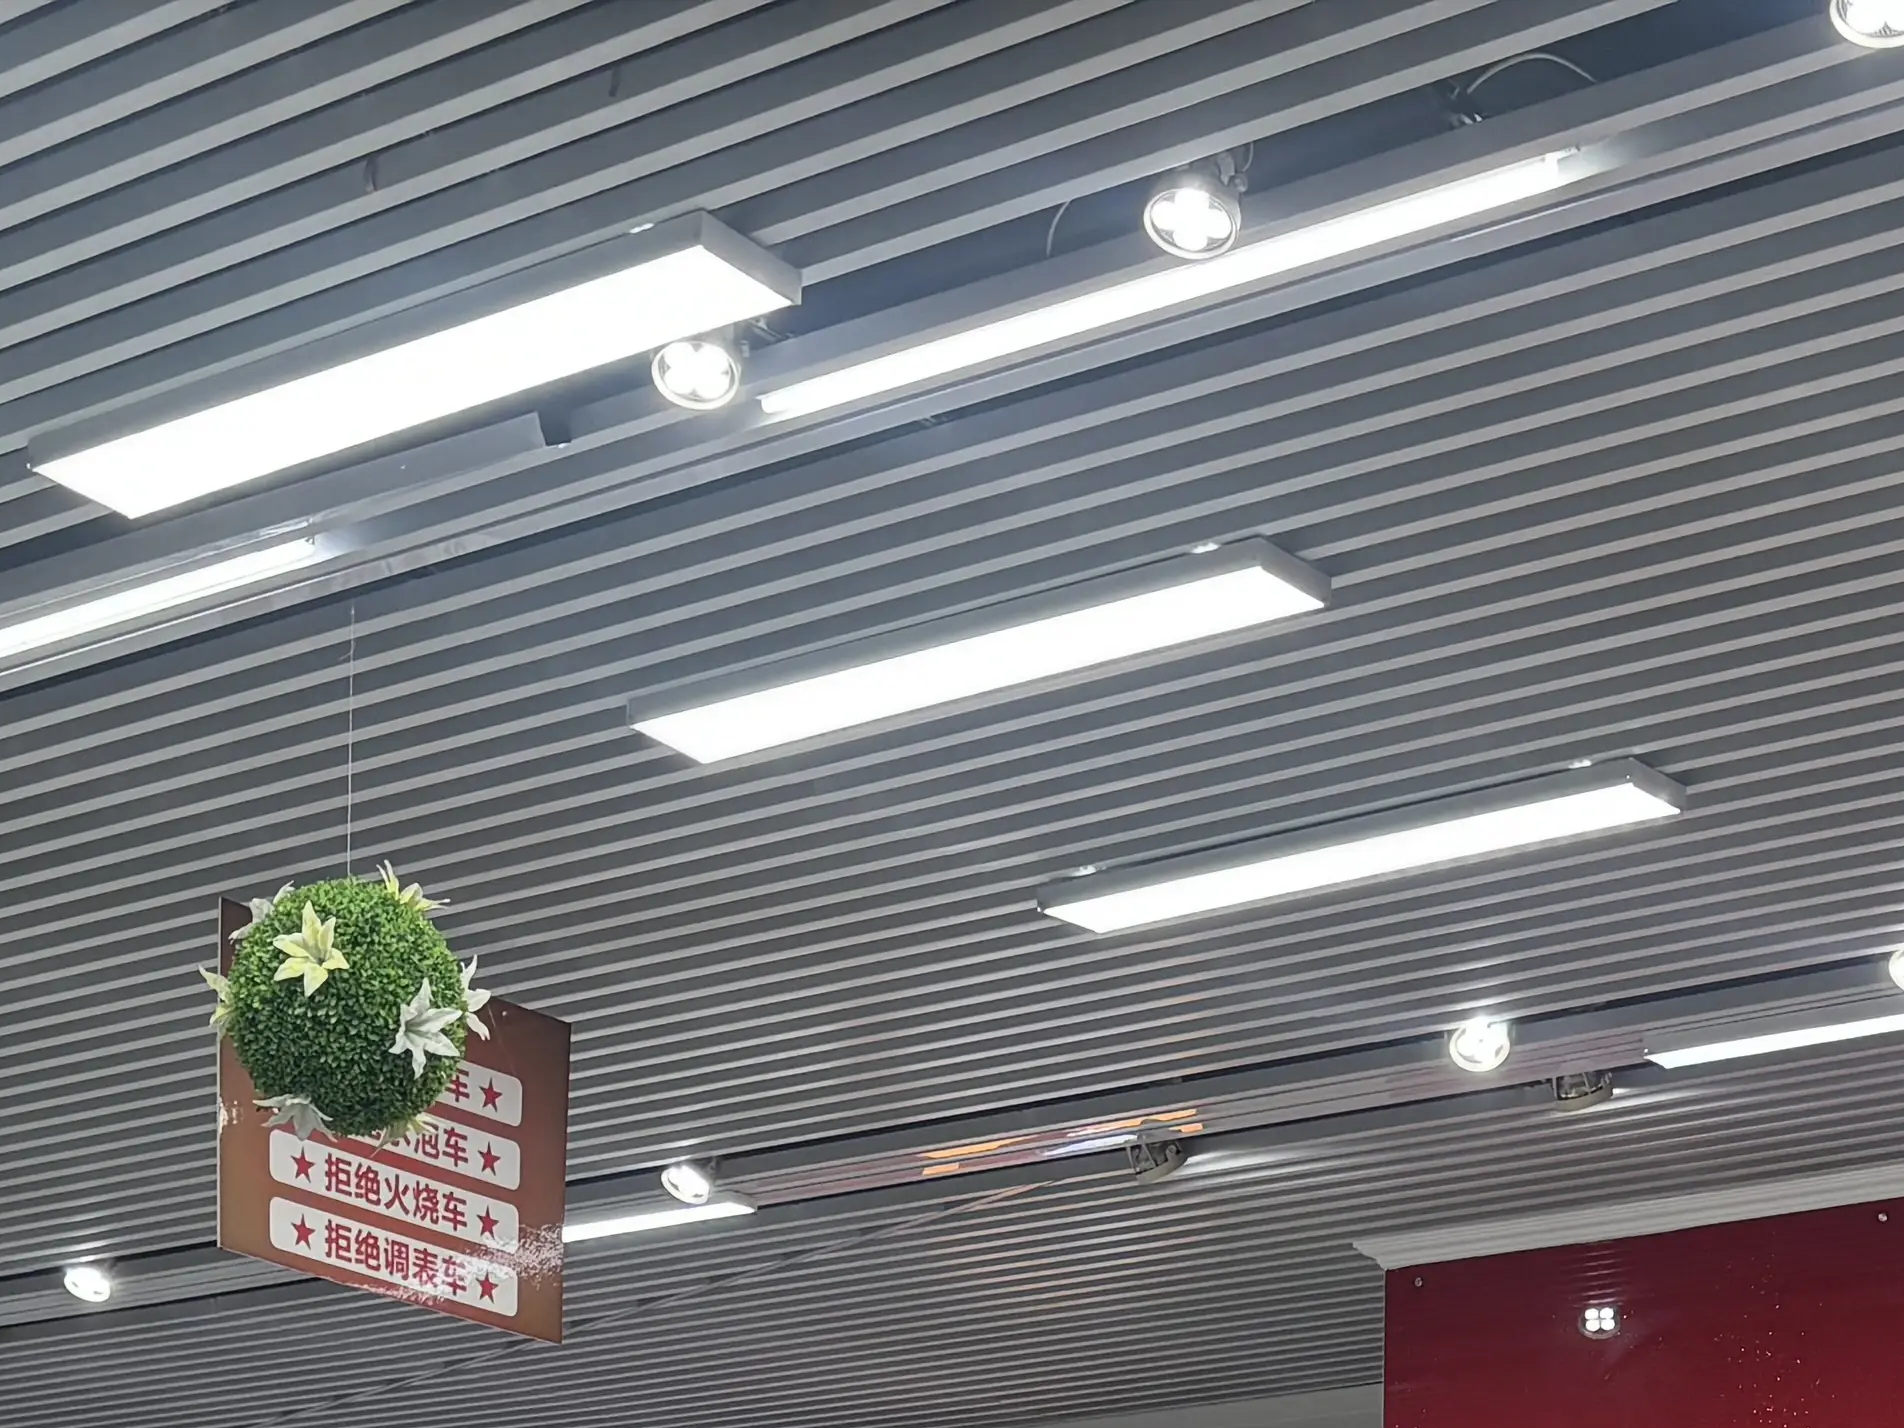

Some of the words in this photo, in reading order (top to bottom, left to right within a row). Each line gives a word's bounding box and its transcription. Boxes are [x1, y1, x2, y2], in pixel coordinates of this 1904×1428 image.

[324, 1153, 469, 1232] 拒绝火烧车
[324, 1218, 469, 1297] 拒绝调表车
